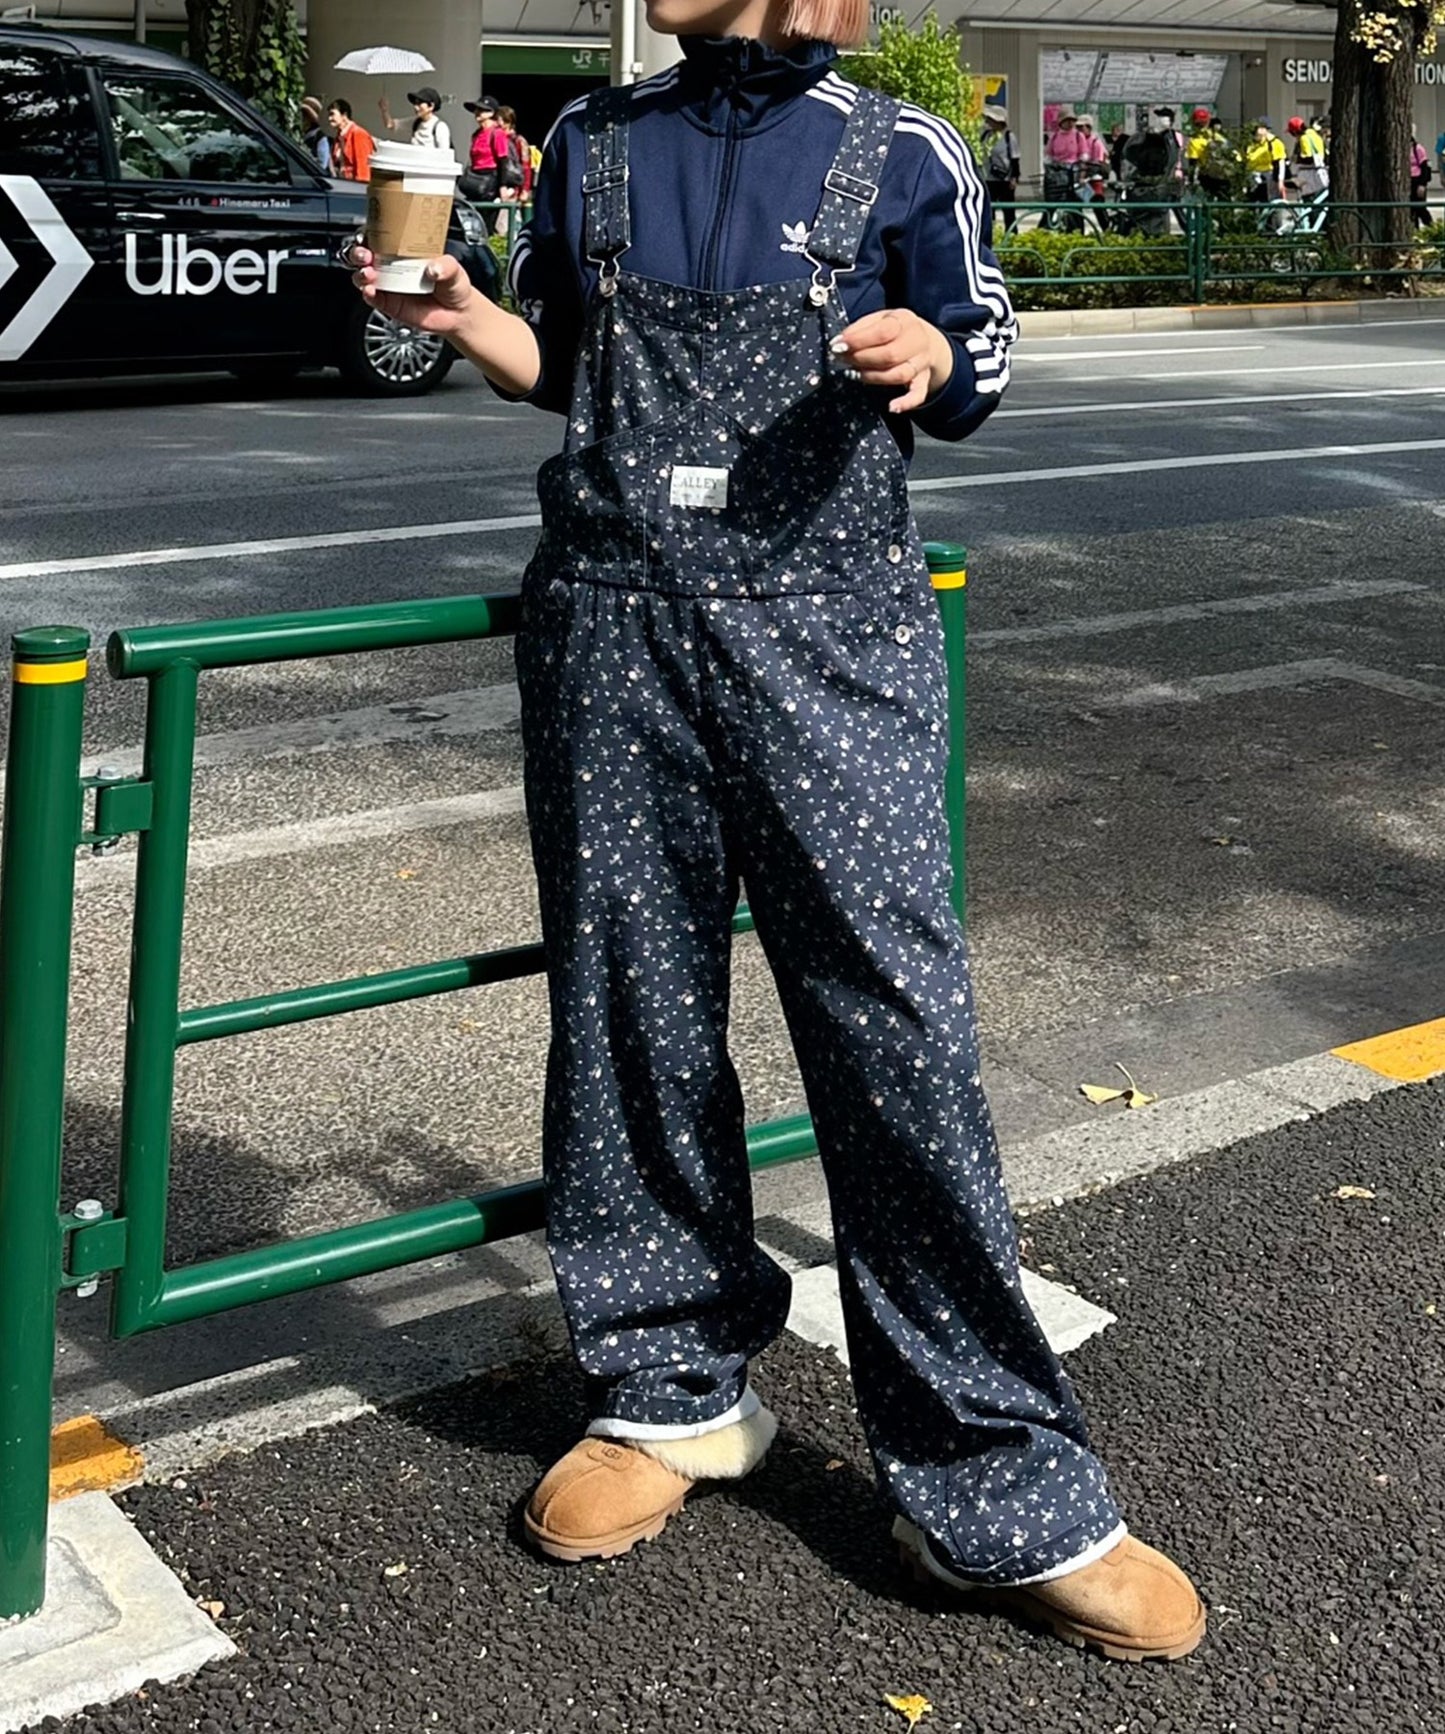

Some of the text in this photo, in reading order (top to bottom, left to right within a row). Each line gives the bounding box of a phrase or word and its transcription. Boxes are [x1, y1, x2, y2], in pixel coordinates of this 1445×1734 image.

[572, 50, 592, 65] JR
[1285, 59, 1445, 84] SEND TION
[780, 243, 805, 253] adid
[126, 233, 289, 295] Uber
